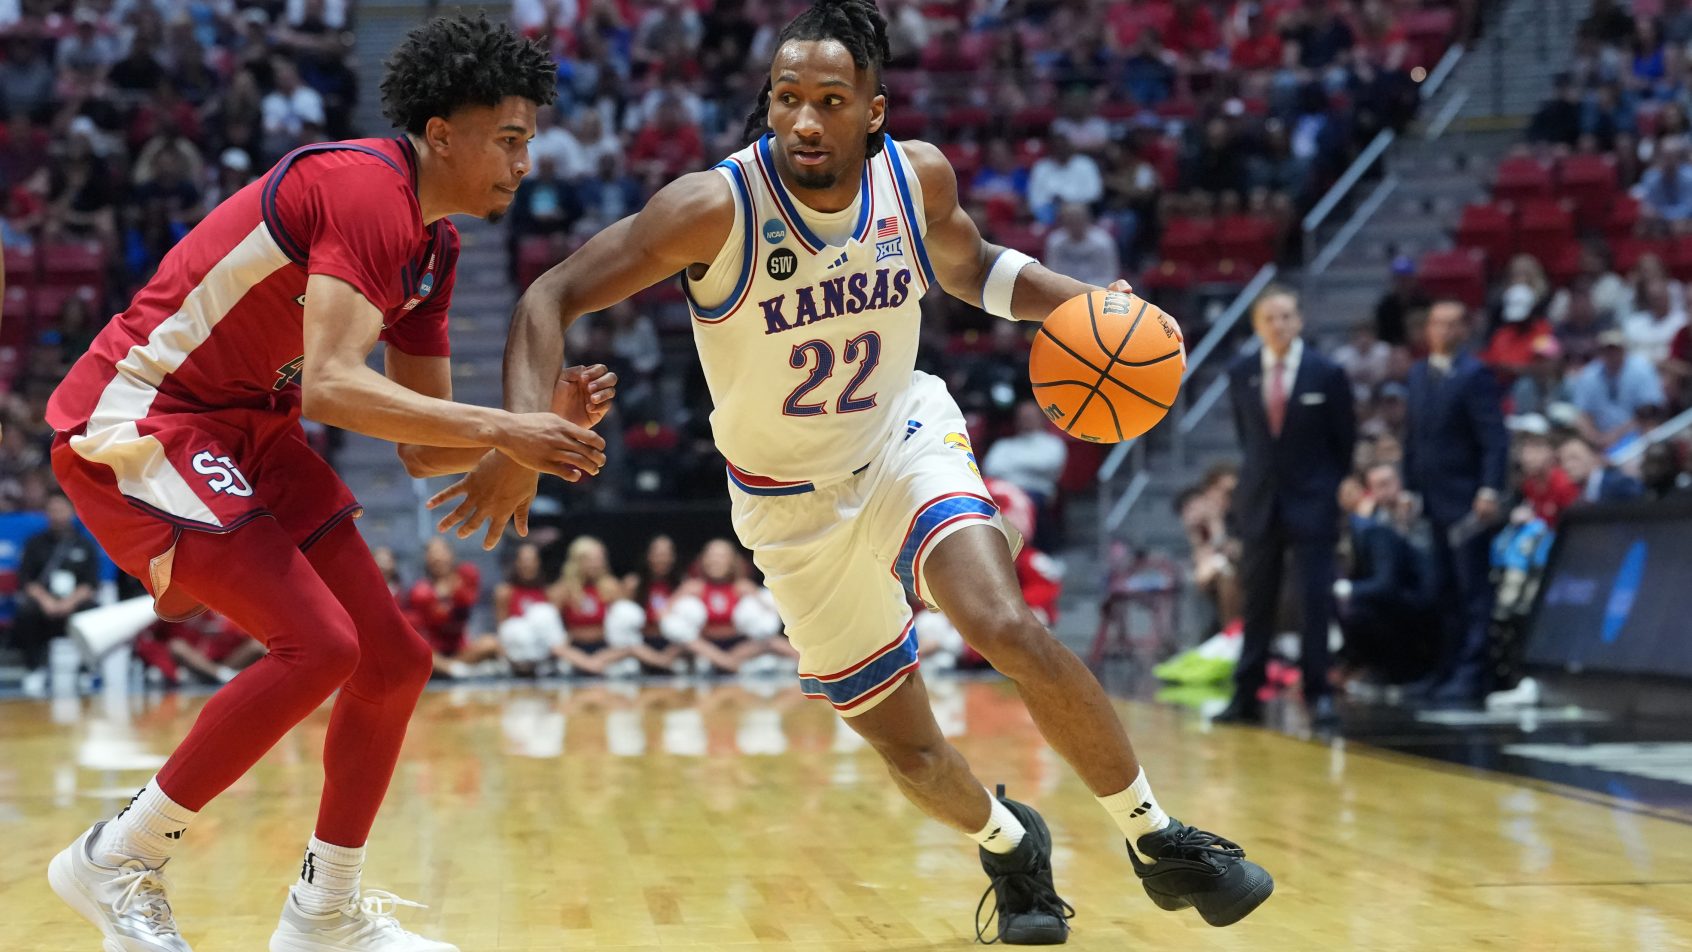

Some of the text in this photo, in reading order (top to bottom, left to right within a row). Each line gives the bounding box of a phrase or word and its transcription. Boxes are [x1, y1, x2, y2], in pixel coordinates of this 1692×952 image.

[766, 230, 785, 239] NCAA
[878, 240, 901, 257] XII
[771, 255, 793, 274] SW
[758, 268, 912, 335] KANSAS
[782, 330, 882, 417] 22
